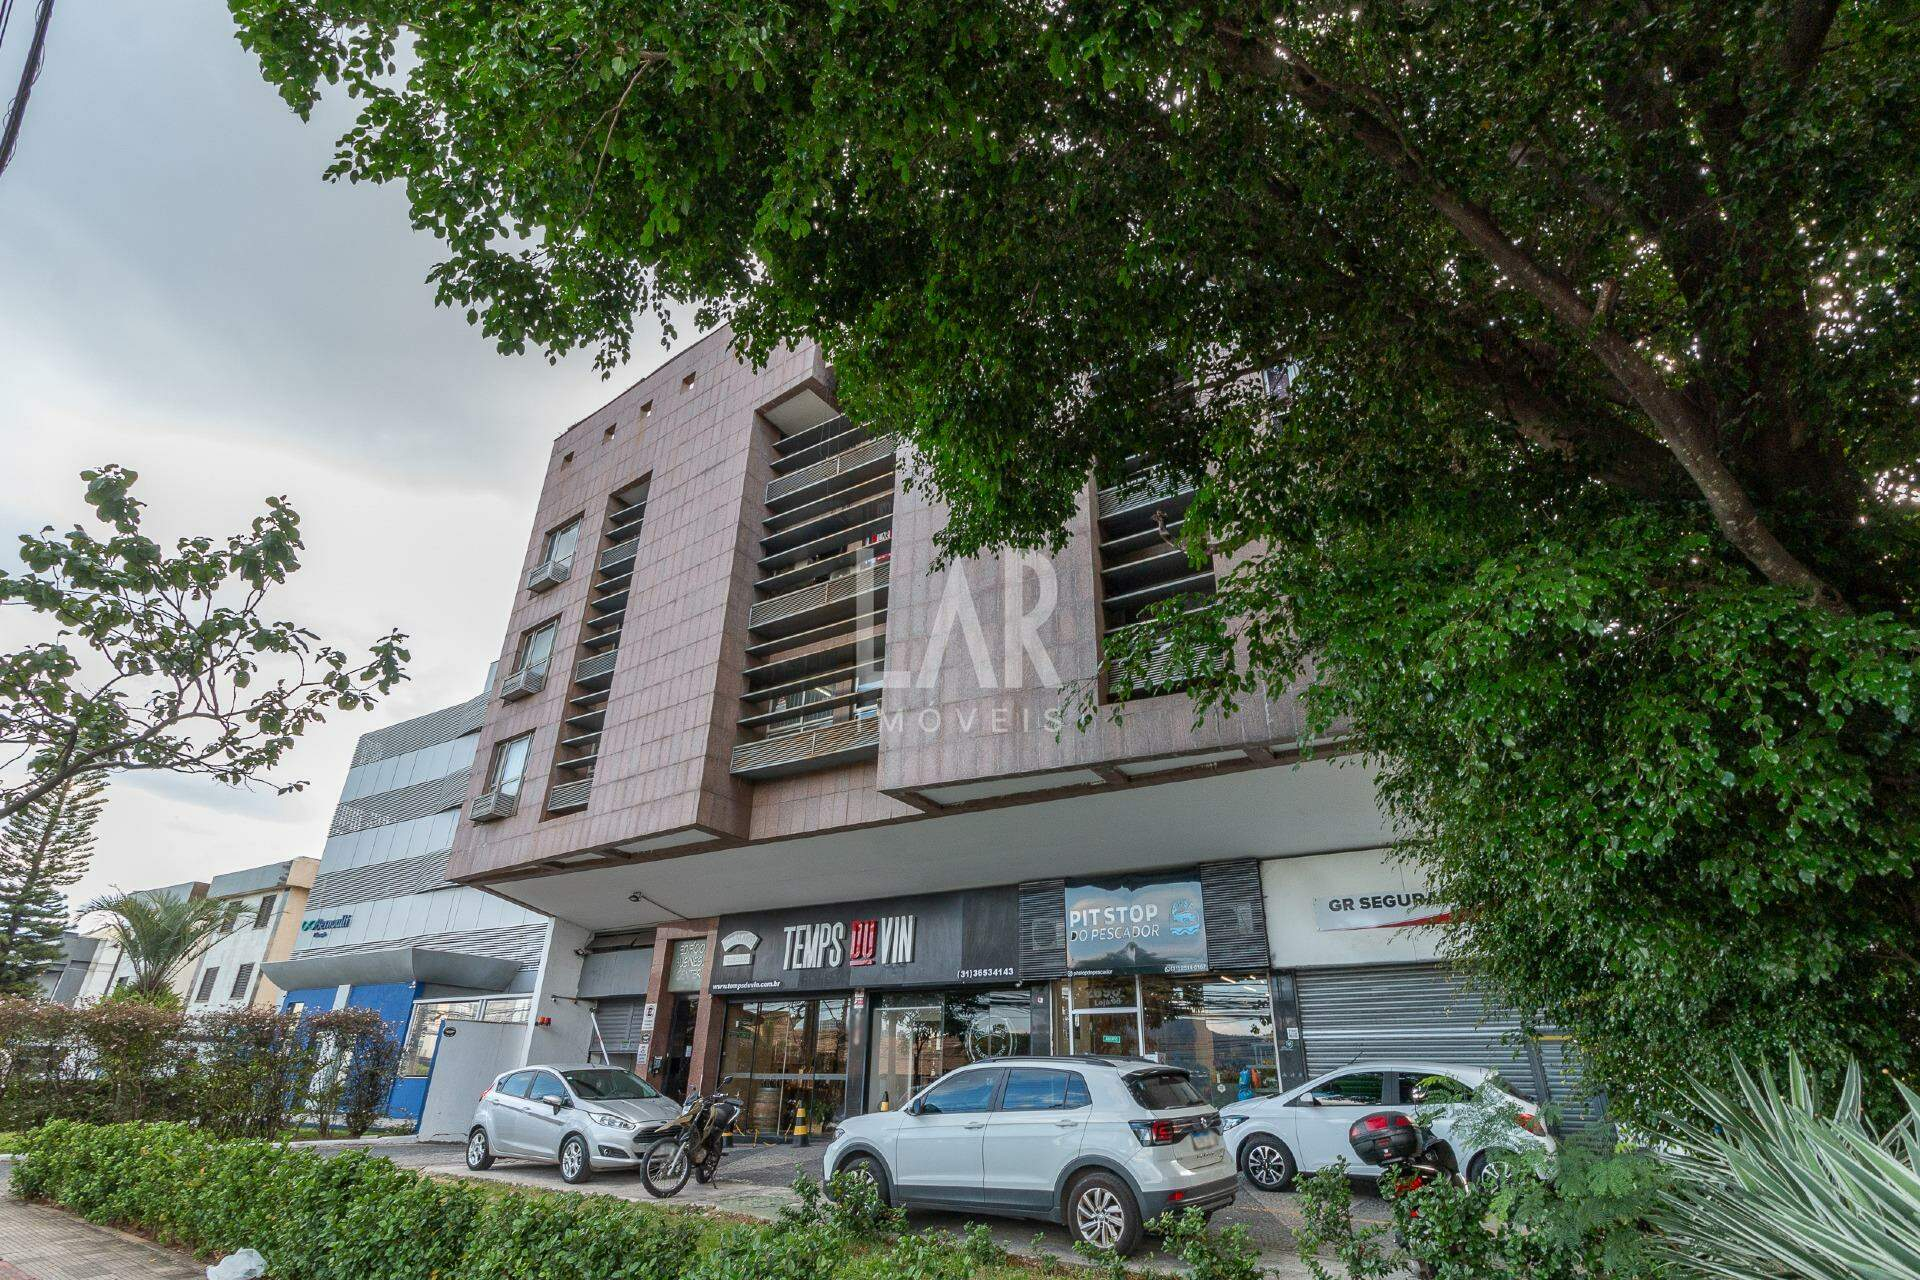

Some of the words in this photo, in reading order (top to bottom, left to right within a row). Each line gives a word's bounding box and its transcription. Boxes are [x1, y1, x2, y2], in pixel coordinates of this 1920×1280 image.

[1328, 898, 1355, 912] GR
[1070, 930, 1088, 942] DO
[1091, 924, 1160, 941] PESCADOR
[782, 921, 845, 971] TEMPS
[849, 919, 878, 961] DU
[881, 914, 914, 965] VIN
